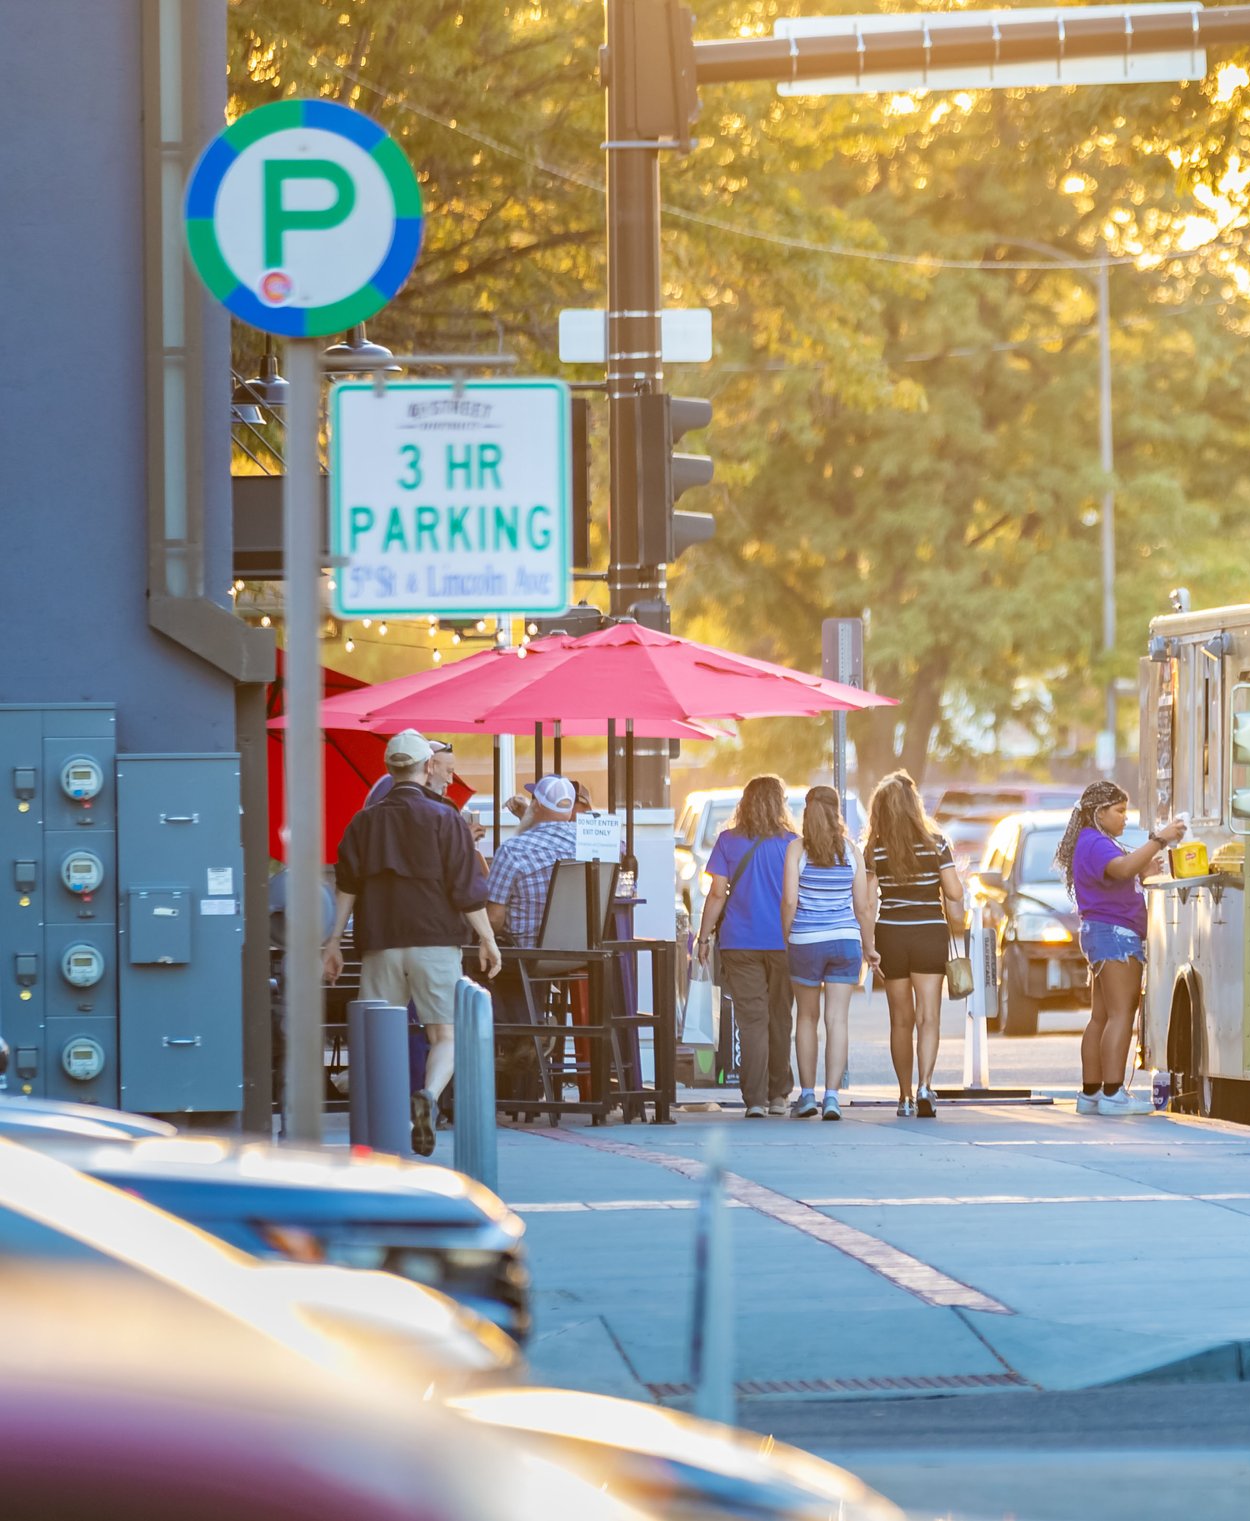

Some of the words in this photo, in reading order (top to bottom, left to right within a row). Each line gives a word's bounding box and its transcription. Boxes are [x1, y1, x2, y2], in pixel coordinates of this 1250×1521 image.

[262, 158, 357, 268] P
[397, 442, 423, 491] 3
[446, 442, 504, 491] HR
[349, 504, 553, 554] PARKING
[426, 562, 508, 598] Lincoln
[598, 819, 619, 827] ENTER
